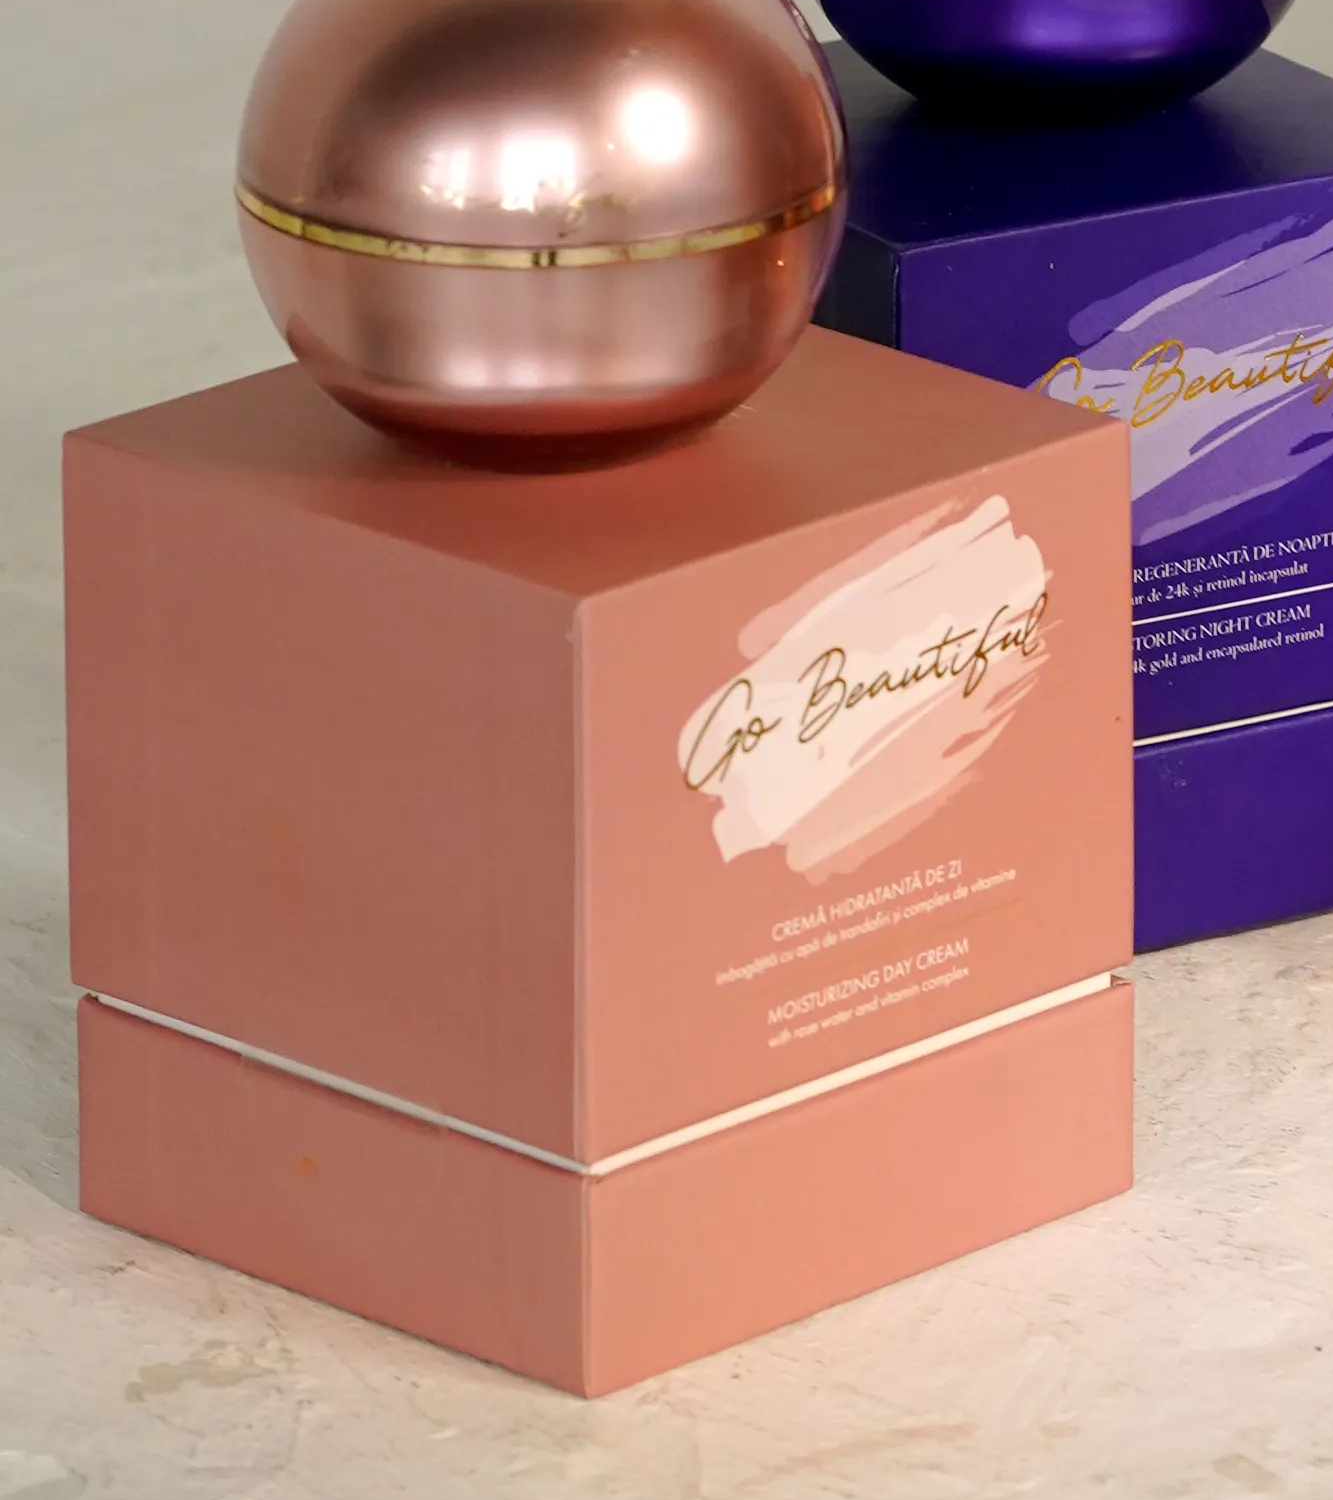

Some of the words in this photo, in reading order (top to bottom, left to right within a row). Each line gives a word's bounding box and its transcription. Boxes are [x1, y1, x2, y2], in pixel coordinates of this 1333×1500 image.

[1252, 542, 1276, 562] DE
[1147, 587, 1162, 603] de
[1165, 581, 1190, 600] 24k
[1206, 570, 1247, 591] retinol
[1131, 625, 1197, 652] TORING
[1199, 615, 1254, 639] NIGHT
[1255, 603, 1312, 627] CREAM
[1149, 651, 1178, 677] gold
[1180, 646, 1203, 664] and
[1205, 630, 1283, 660] encapsulated
[1285, 621, 1325, 643] retinol
[682, 677, 782, 791] Go
[798, 590, 1048, 745] Beautiful
[924, 864, 946, 889] DE
[947, 859, 963, 881] ZI
[902, 892, 951, 921] complex
[952, 881, 969, 901] de
[767, 969, 882, 1027] MOISTURIZING
[882, 956, 914, 985] DAY
[915, 936, 970, 971] CREAM
[854, 995, 879, 1018] and
[921, 965, 971, 993] complex
